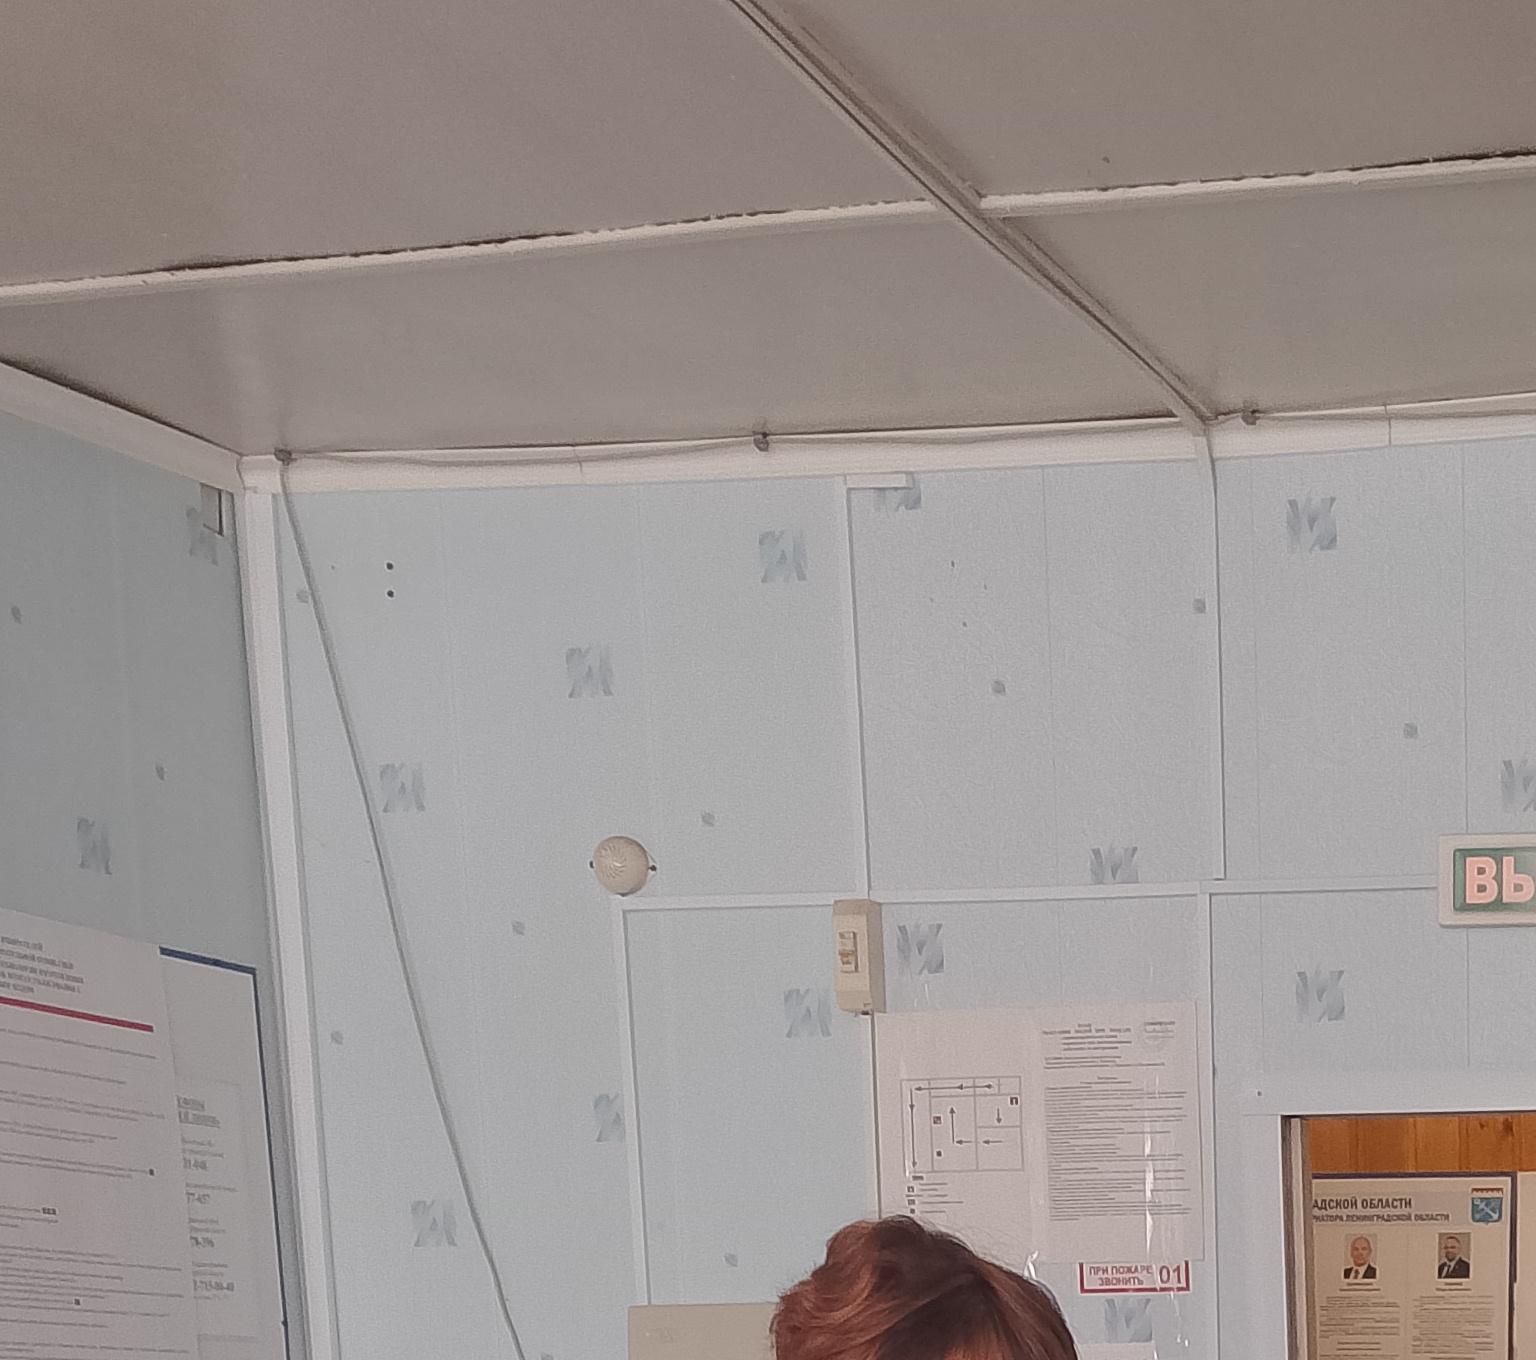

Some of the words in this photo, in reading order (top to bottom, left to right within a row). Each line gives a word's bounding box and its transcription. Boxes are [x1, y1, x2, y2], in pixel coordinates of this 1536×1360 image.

[1312, 1196, 1358, 1211] АДСКОЙ
[1361, 1197, 1412, 1210] ОБЛАСТИ
[1089, 1266, 1108, 1276] ПРИ
[1111, 1264, 1153, 1275] ПОЖАРЕ
[1159, 1264, 1182, 1285] 01
[1098, 1276, 1144, 1286] ЗВОНИТЬ
